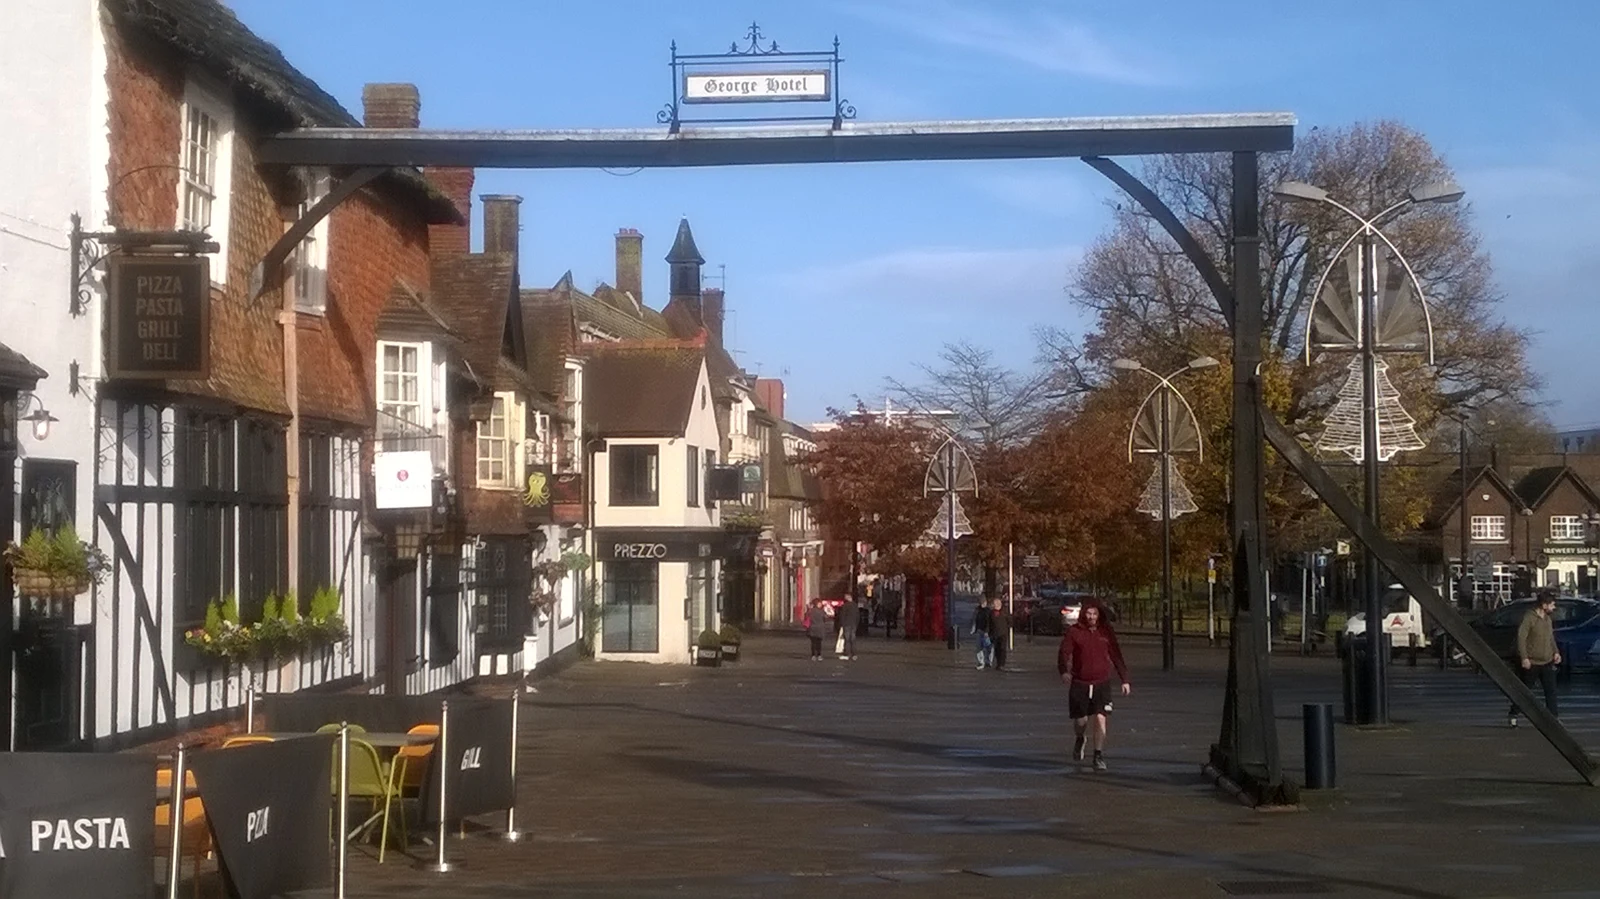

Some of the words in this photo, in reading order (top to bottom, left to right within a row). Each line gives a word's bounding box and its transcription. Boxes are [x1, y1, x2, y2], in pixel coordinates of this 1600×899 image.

[704, 79, 758, 94] George
[765, 77, 808, 93] Hotel
[137, 275, 183, 294] PIZZA
[135, 297, 184, 316] PASTA
[137, 320, 182, 339] GRILL
[142, 342, 178, 360] DELI
[614, 543, 667, 558] PREZZO
[31, 817, 131, 852] PASTA
